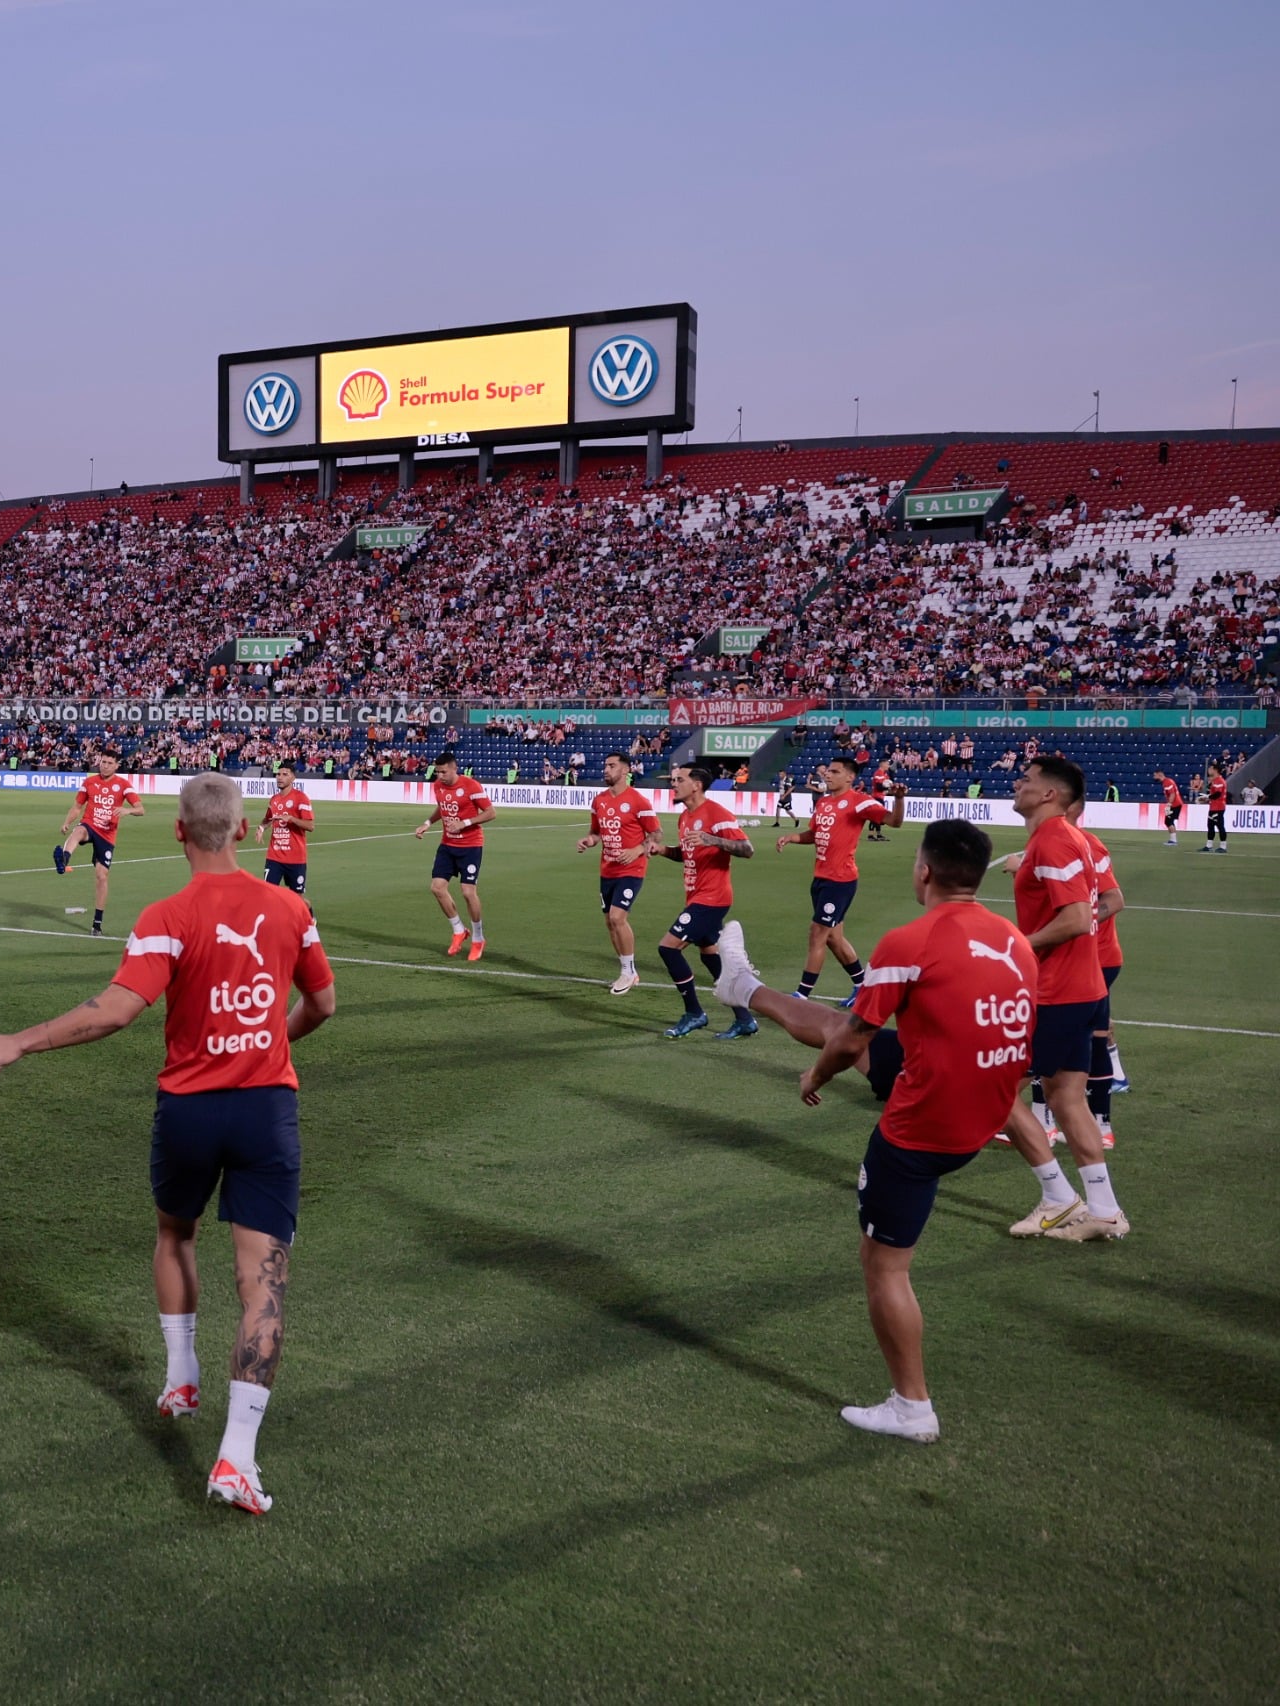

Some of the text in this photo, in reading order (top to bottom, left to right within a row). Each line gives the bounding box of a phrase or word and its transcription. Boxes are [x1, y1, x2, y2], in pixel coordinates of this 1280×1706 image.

[400, 376, 427, 389] Shell
[400, 382, 545, 406] Formula Super
[417, 432, 470, 446] DIESA
[365, 532, 419, 544] SALID
[149, 706, 297, 722] DEFENSORES
[304, 707, 350, 723] DEL
[884, 715, 930, 727] ueno
[977, 715, 1027, 727] ueno
[1076, 715, 1128, 728] ueno
[1181, 715, 1238, 728] ueno
[32, 775, 87, 788] QUALIFIE
[491, 788, 499, 802] LA
[570, 791, 585, 806] UNA
[936, 802, 954, 819] UNA
[1233, 809, 1266, 828] JUEGA
[207, 1030, 272, 1055] ueno
